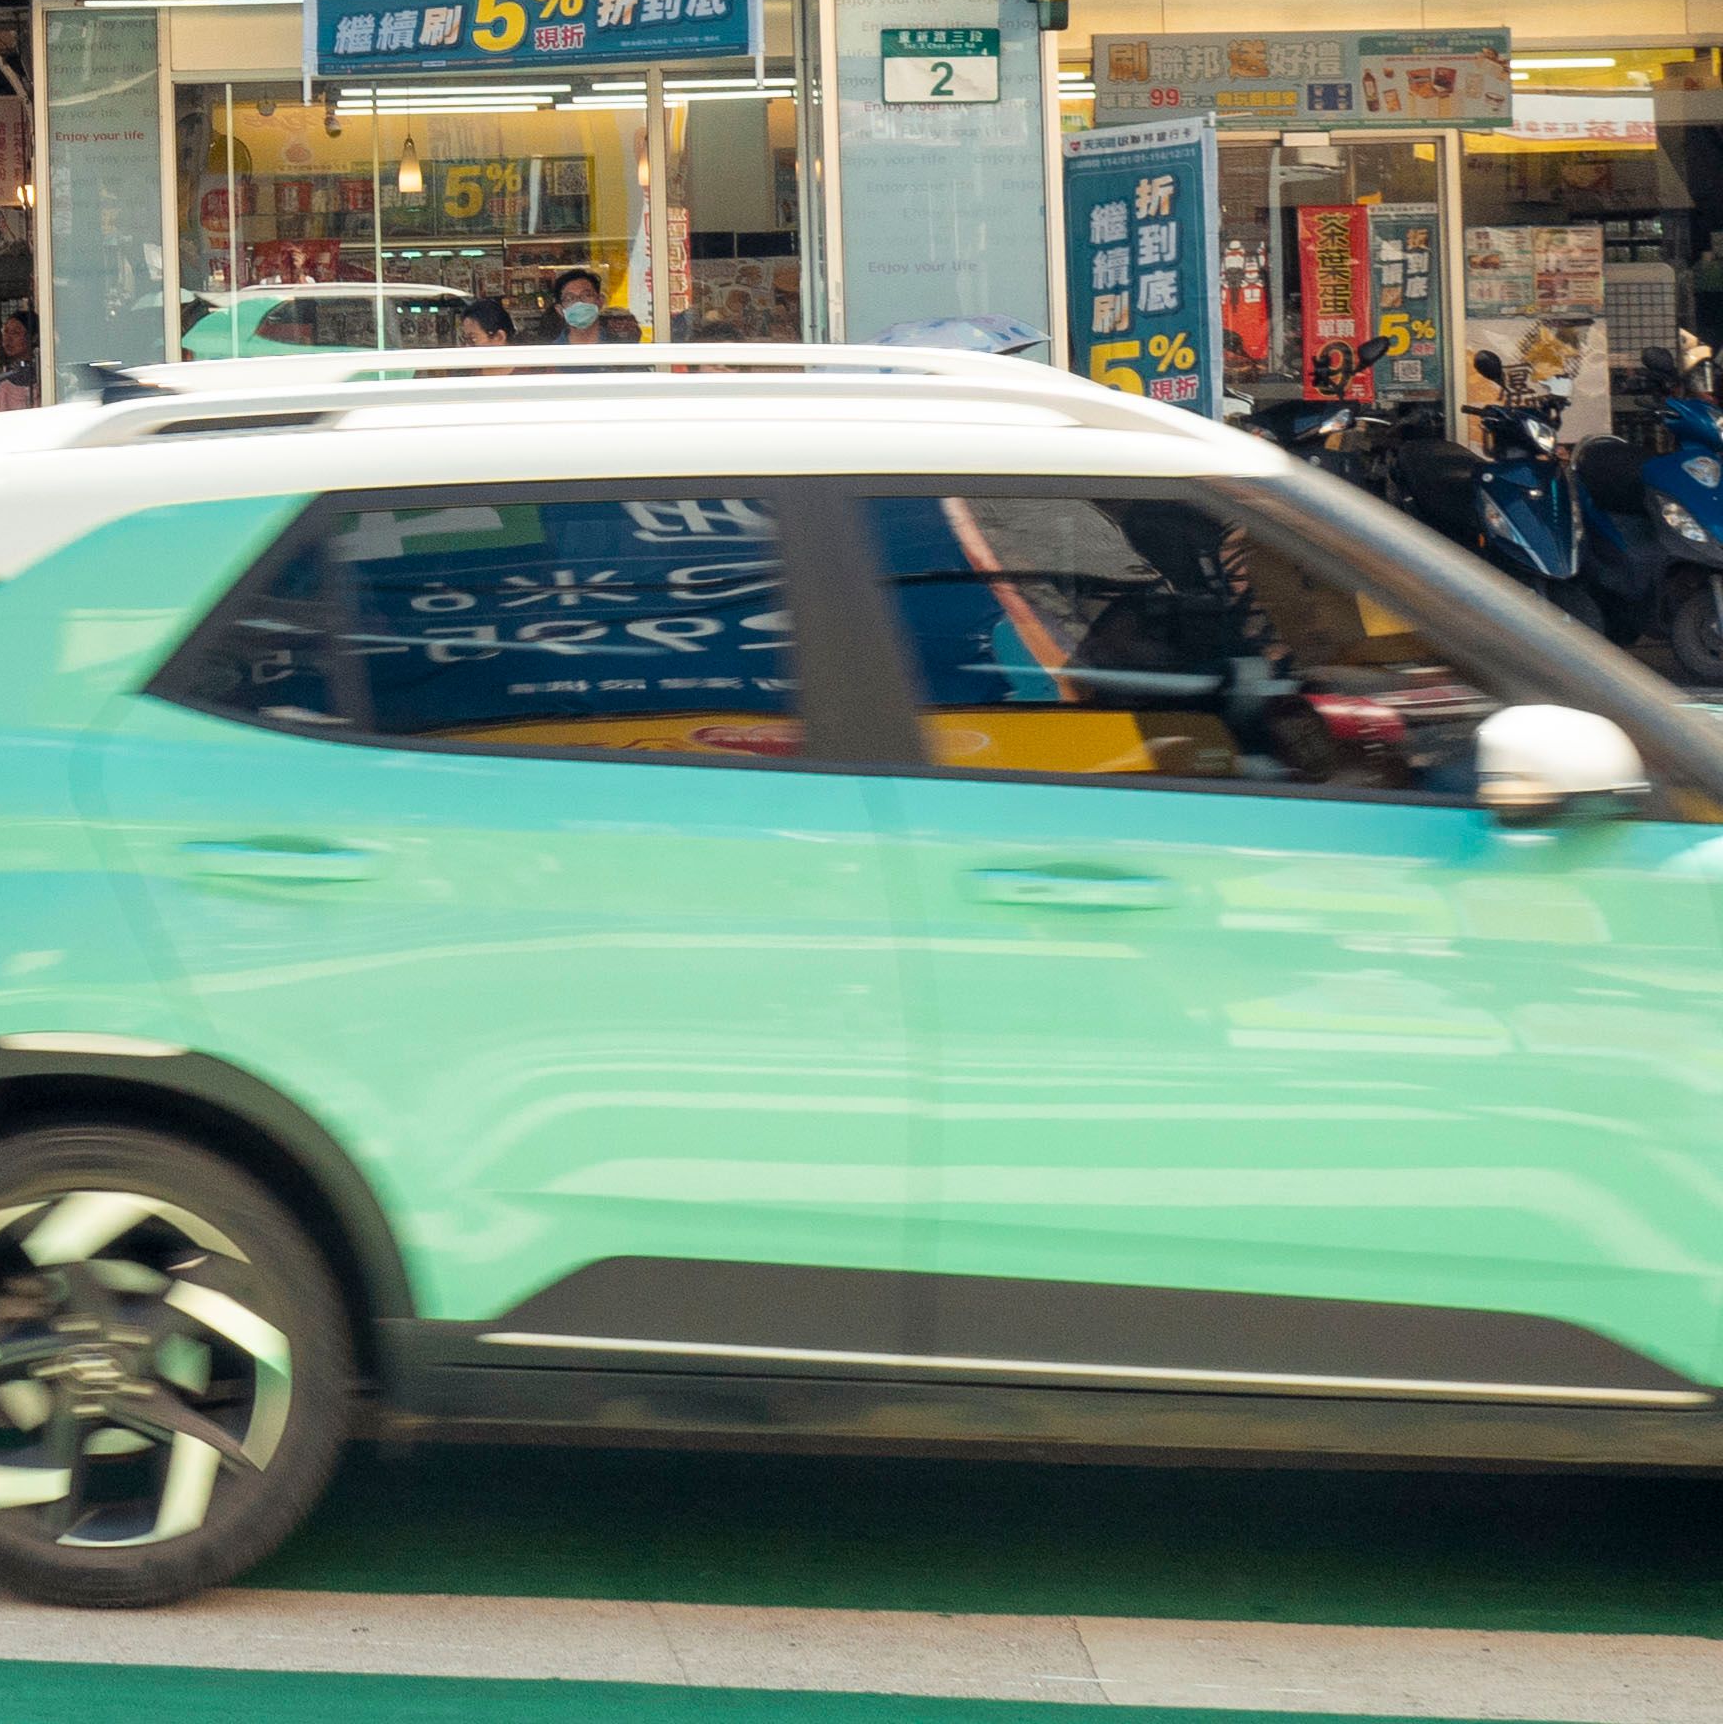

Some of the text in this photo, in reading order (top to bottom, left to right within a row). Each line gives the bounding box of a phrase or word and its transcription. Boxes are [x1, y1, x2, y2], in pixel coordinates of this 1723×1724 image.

[333, 5, 463, 55] 繼續刷
[534, 23, 586, 51] 現折
[930, 62, 954, 96] 2
[54, 130, 145, 143] Enjoy your life
[1089, 200, 1132, 333] 繼續刷
[1135, 174, 1179, 313] 折到底
[1315, 212, 1352, 317] 茶葉蛋
[1378, 314, 1436, 356] 5%
